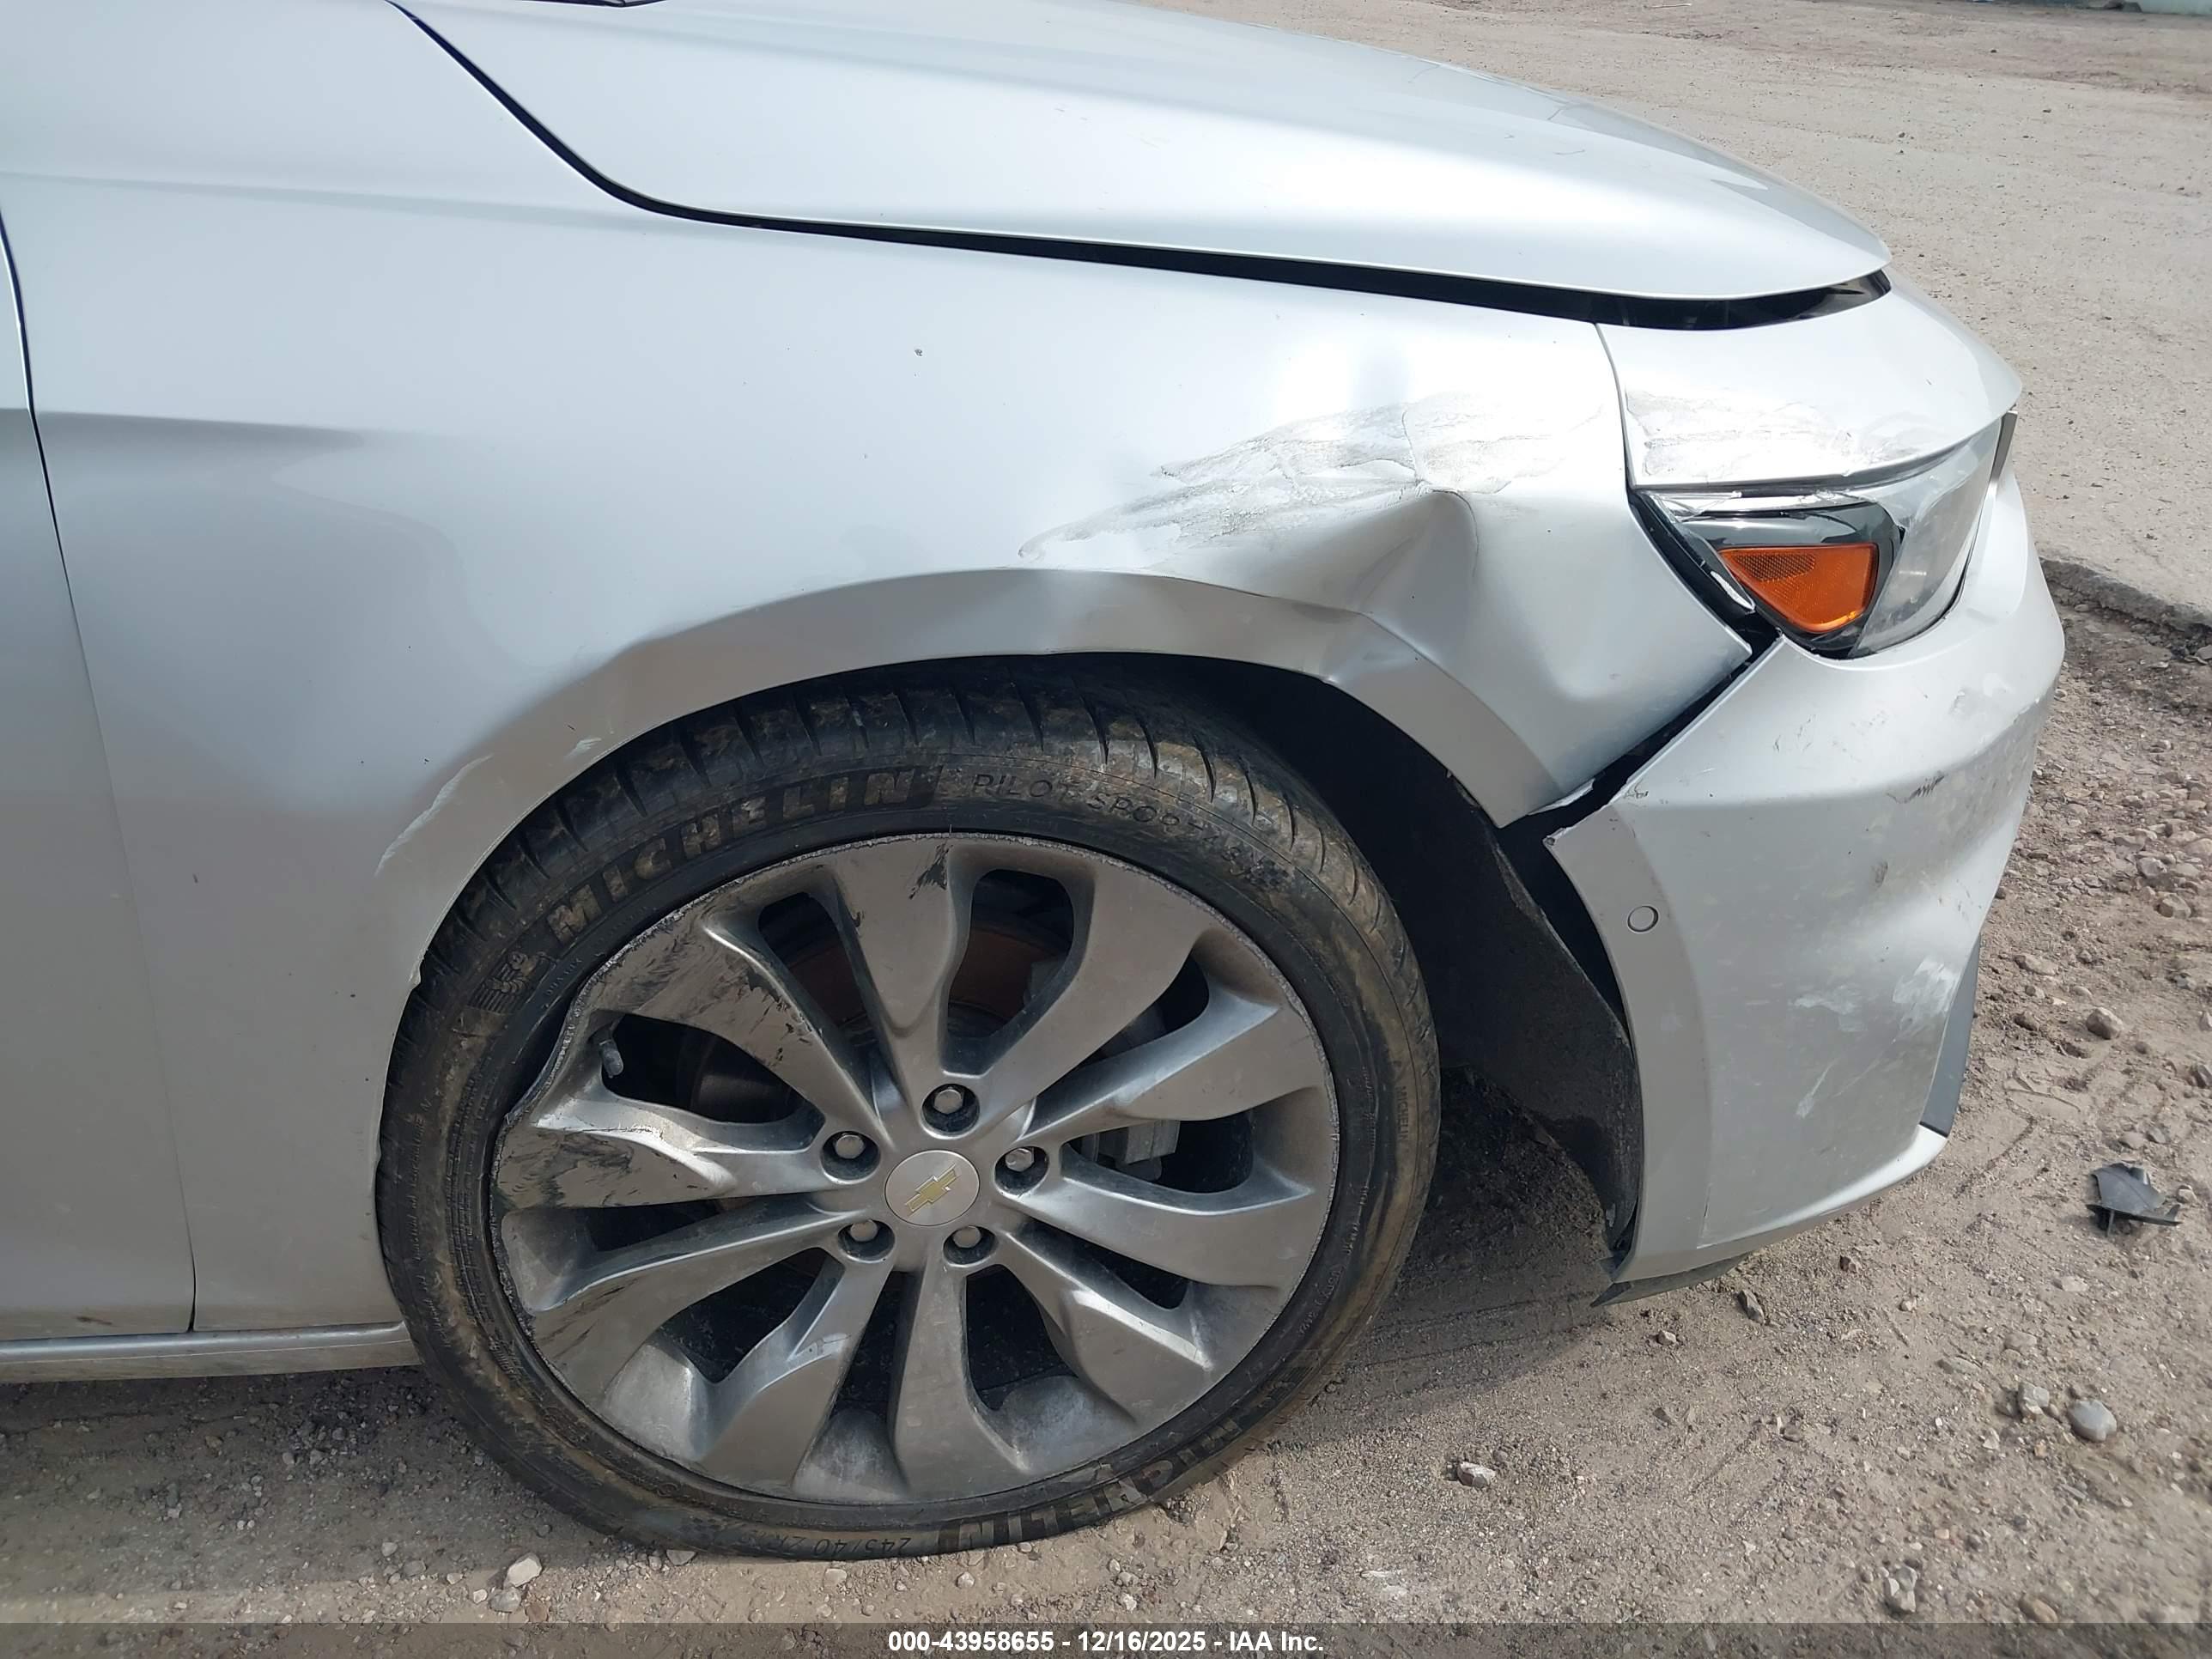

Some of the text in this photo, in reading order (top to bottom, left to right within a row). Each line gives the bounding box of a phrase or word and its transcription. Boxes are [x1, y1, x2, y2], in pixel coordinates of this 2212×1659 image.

[972, 773, 1077, 809] PILOT
[546, 769, 916, 943] MICHELIN
[1396, 1085, 1410, 1142] MICHELIN
[957, 1418, 1243, 1547] MICHELIN
[813, 1537, 912, 1558] 245/40
